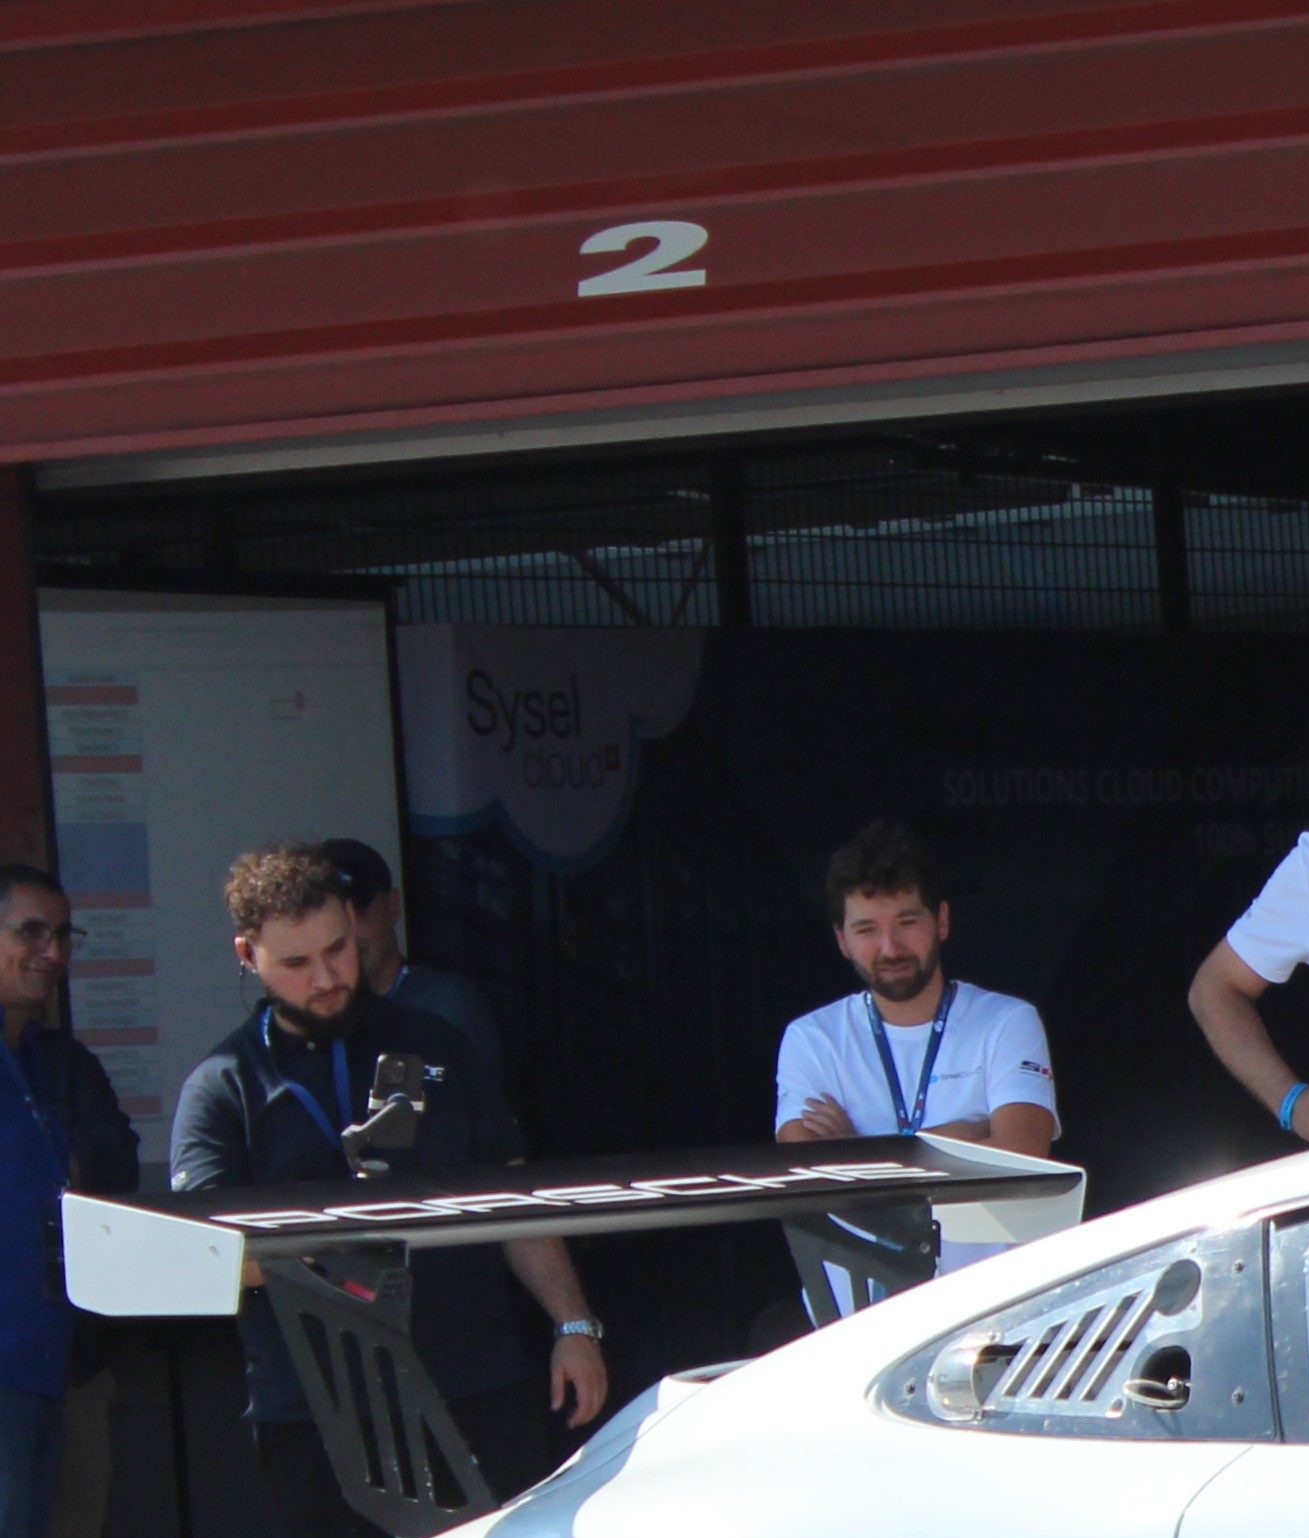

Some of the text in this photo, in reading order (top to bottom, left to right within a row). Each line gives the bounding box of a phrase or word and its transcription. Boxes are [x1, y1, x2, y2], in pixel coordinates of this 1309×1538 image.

[577, 220, 709, 297] 2
[465, 669, 581, 753] Sysel
[209, 1161, 949, 1229] PORSCHE
